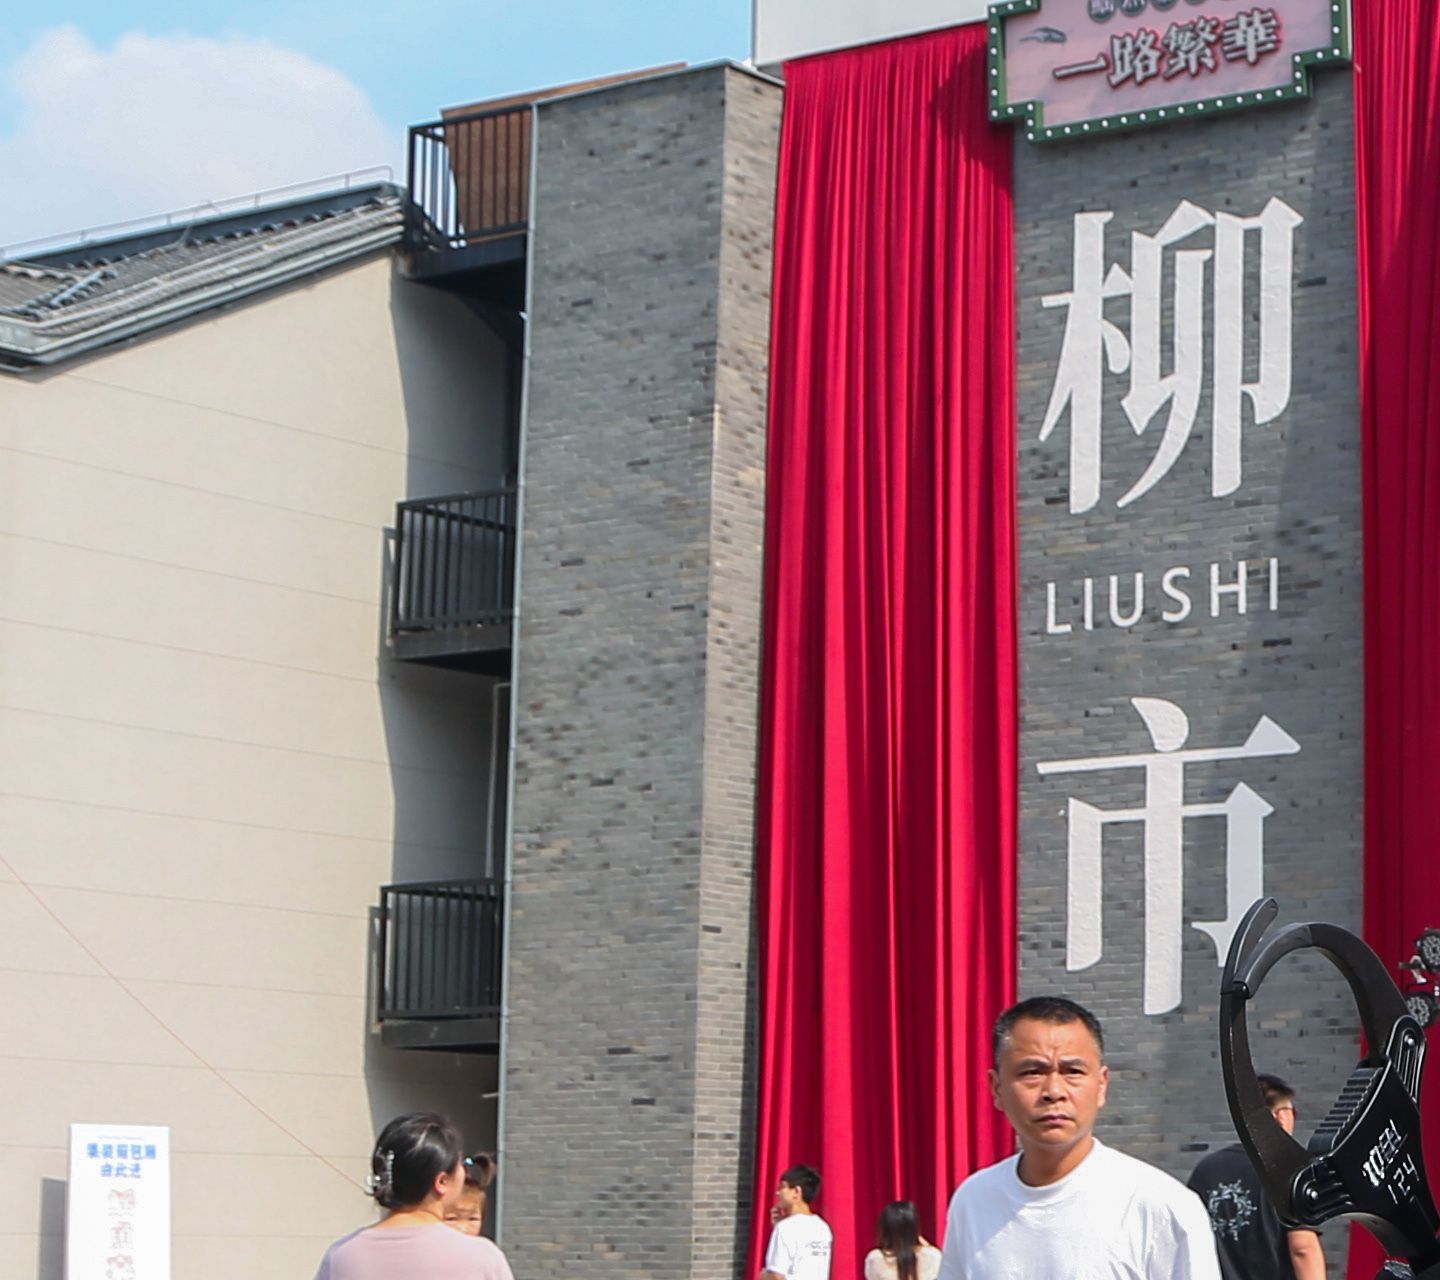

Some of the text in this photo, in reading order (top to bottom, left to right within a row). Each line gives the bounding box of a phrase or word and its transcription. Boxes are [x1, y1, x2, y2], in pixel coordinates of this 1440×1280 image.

[1053, 8, 1281, 88] 一路繁華
[1038, 196, 1305, 514] 柳
[1045, 558, 1280, 635] LIUSHI
[1036, 697, 1302, 1016] 市
